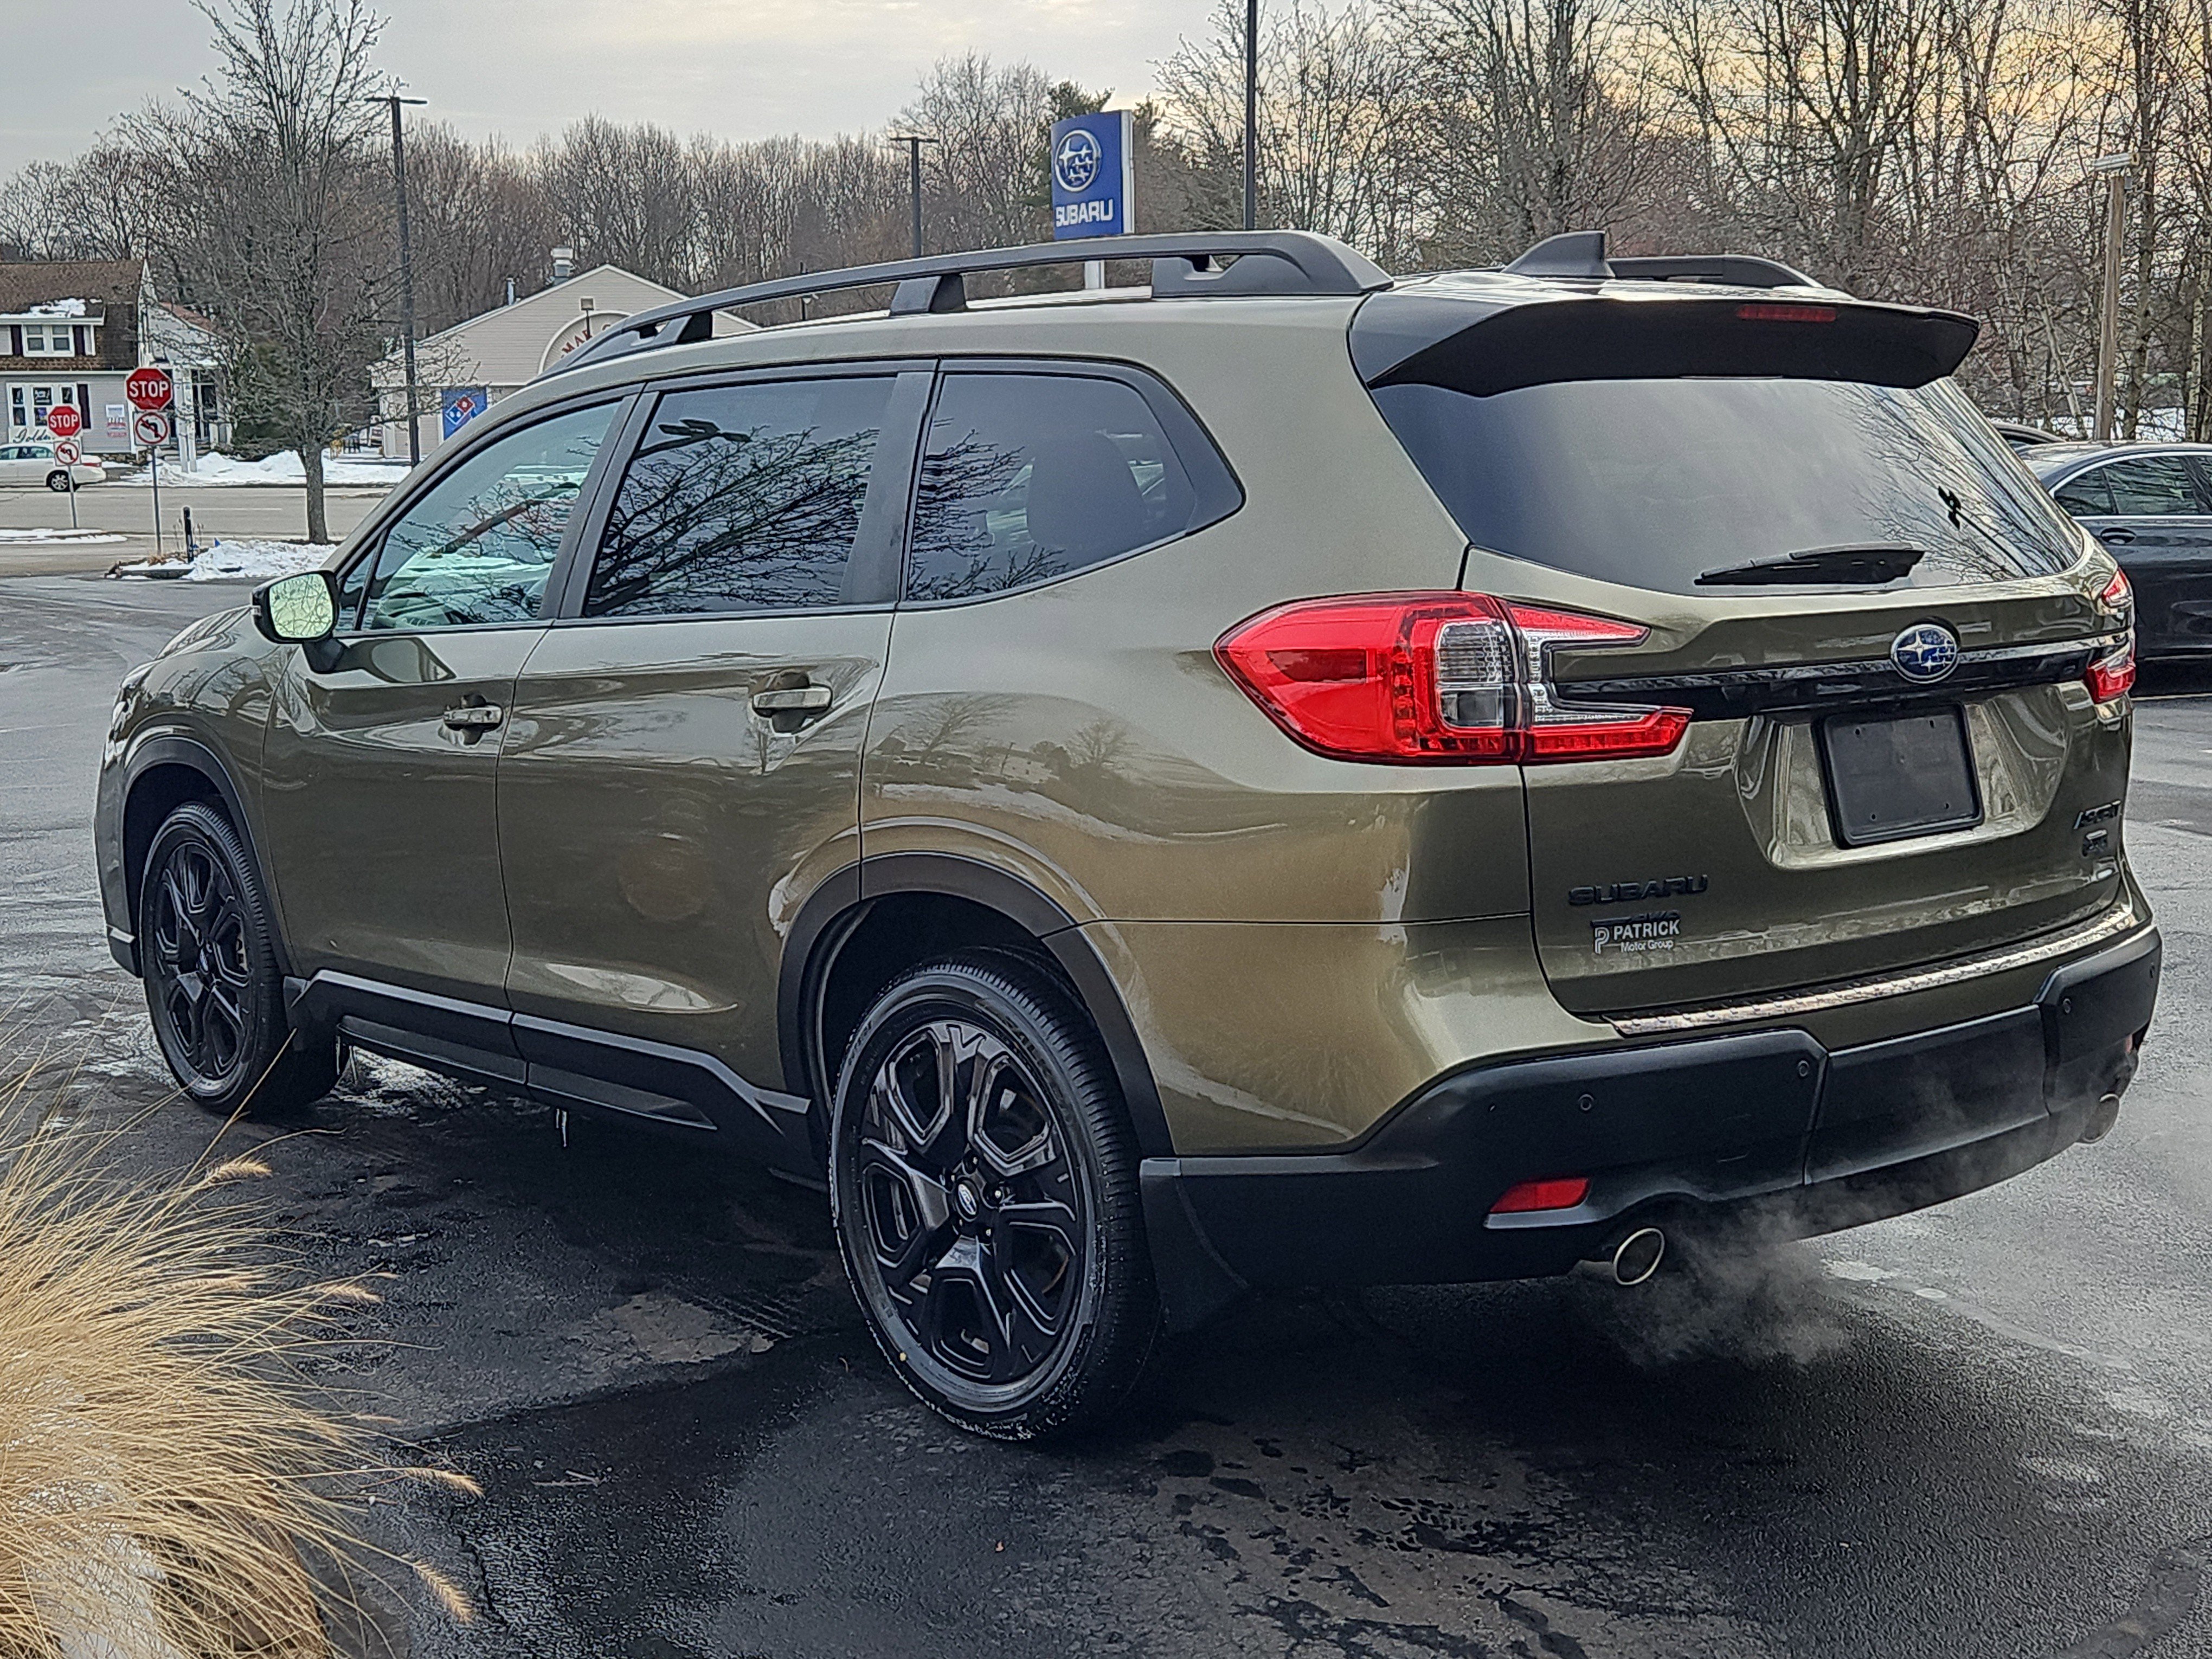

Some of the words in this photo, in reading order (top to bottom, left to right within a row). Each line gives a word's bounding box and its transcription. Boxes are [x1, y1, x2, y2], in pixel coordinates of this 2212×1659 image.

[1056, 199, 1114, 227] SUBARU
[129, 381, 169, 397] STOP
[50, 414, 78, 428] STOP
[1568, 874, 1708, 905] SUBARU
[1613, 919, 1680, 941] PATRICK
[1621, 941, 1646, 953] Motor
[1647, 939, 1674, 951] Group
